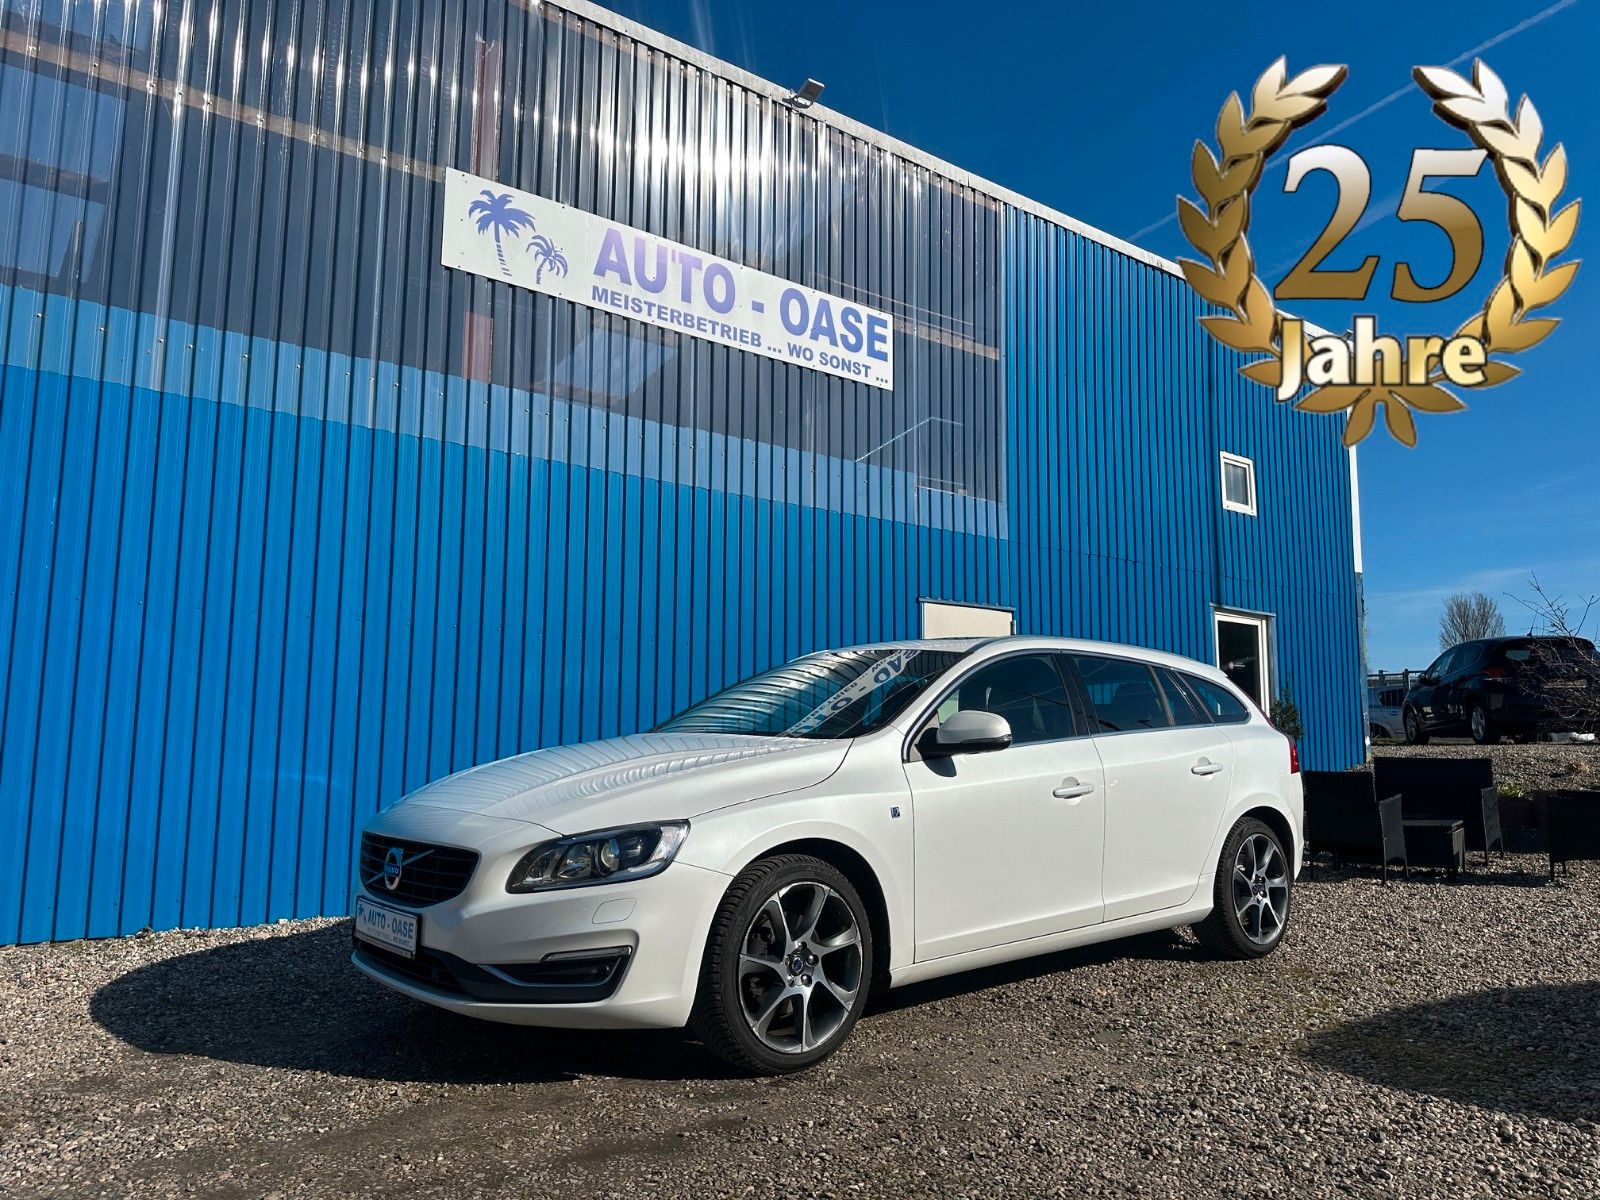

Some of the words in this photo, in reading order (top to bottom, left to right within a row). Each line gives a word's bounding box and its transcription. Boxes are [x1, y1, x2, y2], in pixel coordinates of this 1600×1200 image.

[591, 284, 762, 348] MEISTERBETRIEB
[787, 342, 814, 361] WO
[819, 352, 871, 378] SONST
[593, 227, 736, 315] AUTO
[780, 287, 888, 362] OASE
[368, 909, 386, 930] AUTO
[392, 917, 414, 940] OASE
